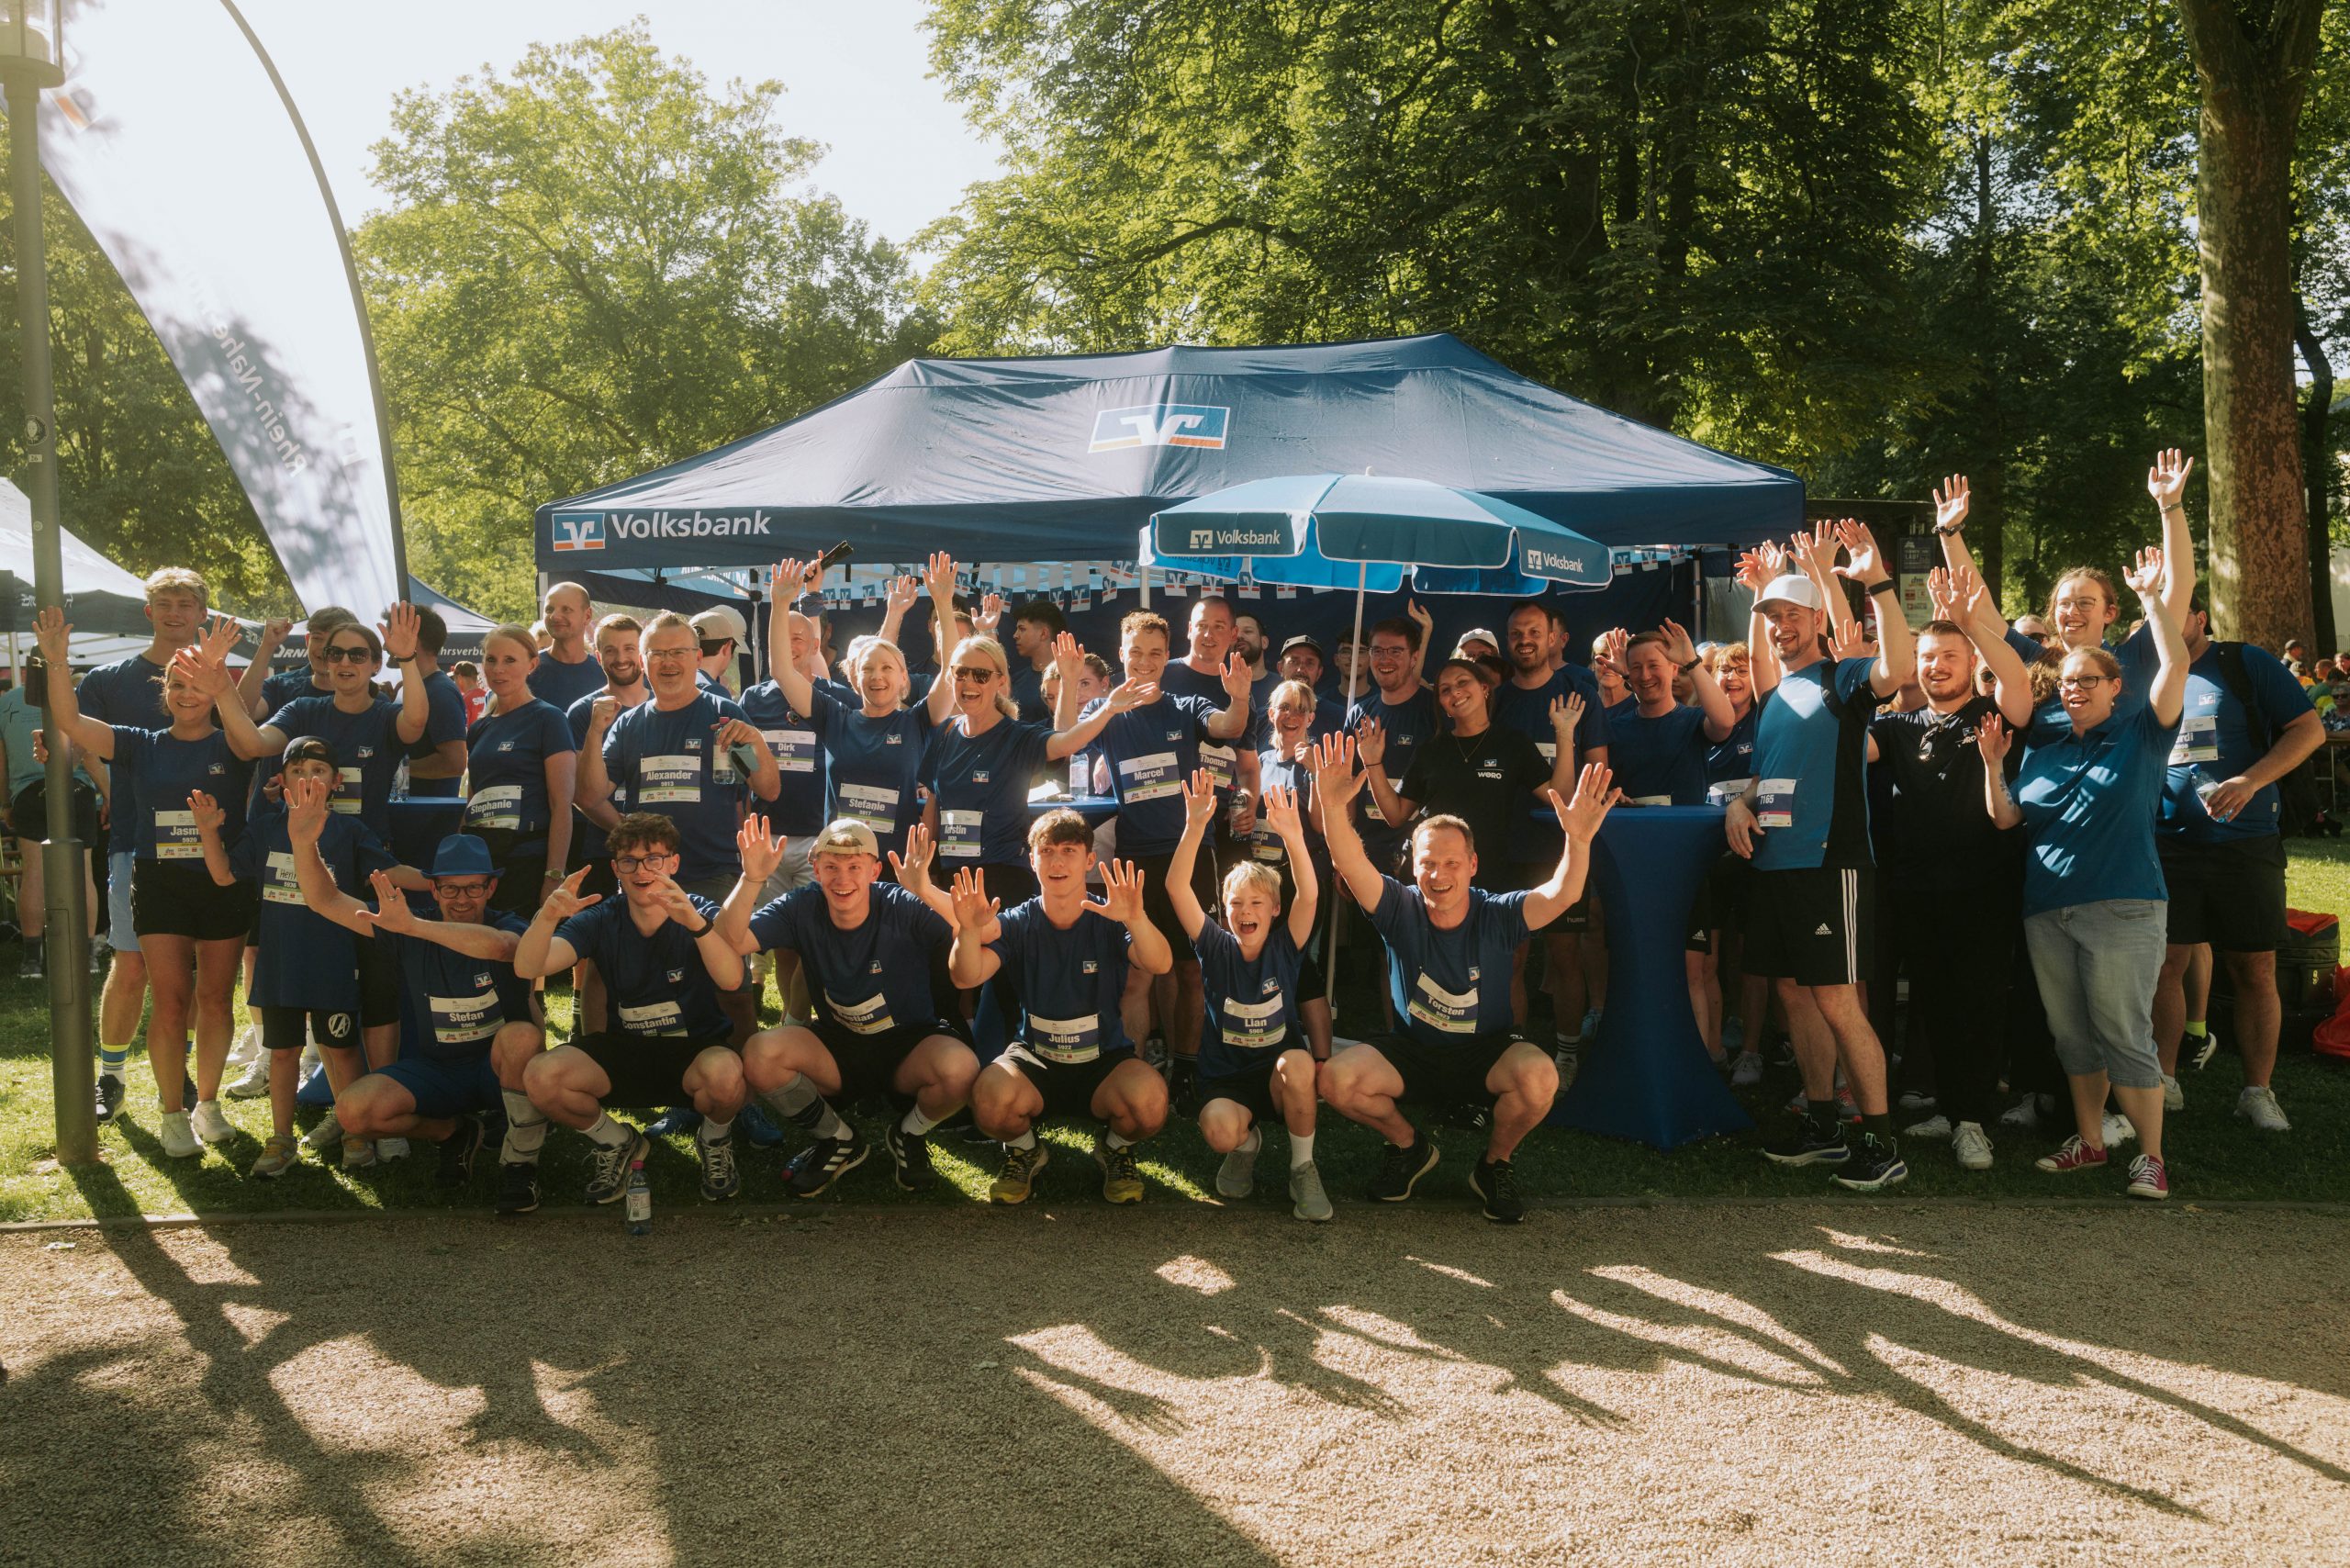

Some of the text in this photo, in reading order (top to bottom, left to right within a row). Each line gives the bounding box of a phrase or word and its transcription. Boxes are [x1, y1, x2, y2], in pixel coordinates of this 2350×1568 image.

[610, 510, 772, 539] Volksbank
[1216, 529, 1281, 544] Volksbank
[1543, 552, 1583, 573] Volksbank
[778, 743, 796, 752] Dirk
[1200, 754, 1227, 768] Thomas
[645, 770, 693, 781] Alexander
[1134, 767, 1165, 781] Marcel
[470, 799, 512, 814] Stephanie
[848, 798, 886, 812] Stefanie
[1760, 794, 1774, 805] 7165
[170, 826, 199, 835] Jasm
[1427, 995, 1465, 1016] Torsten
[449, 1011, 485, 1022] Stefan
[622, 1016, 677, 1030] Constantin
[1245, 1018, 1267, 1027] Lian
[1048, 1034, 1080, 1044] Julius
